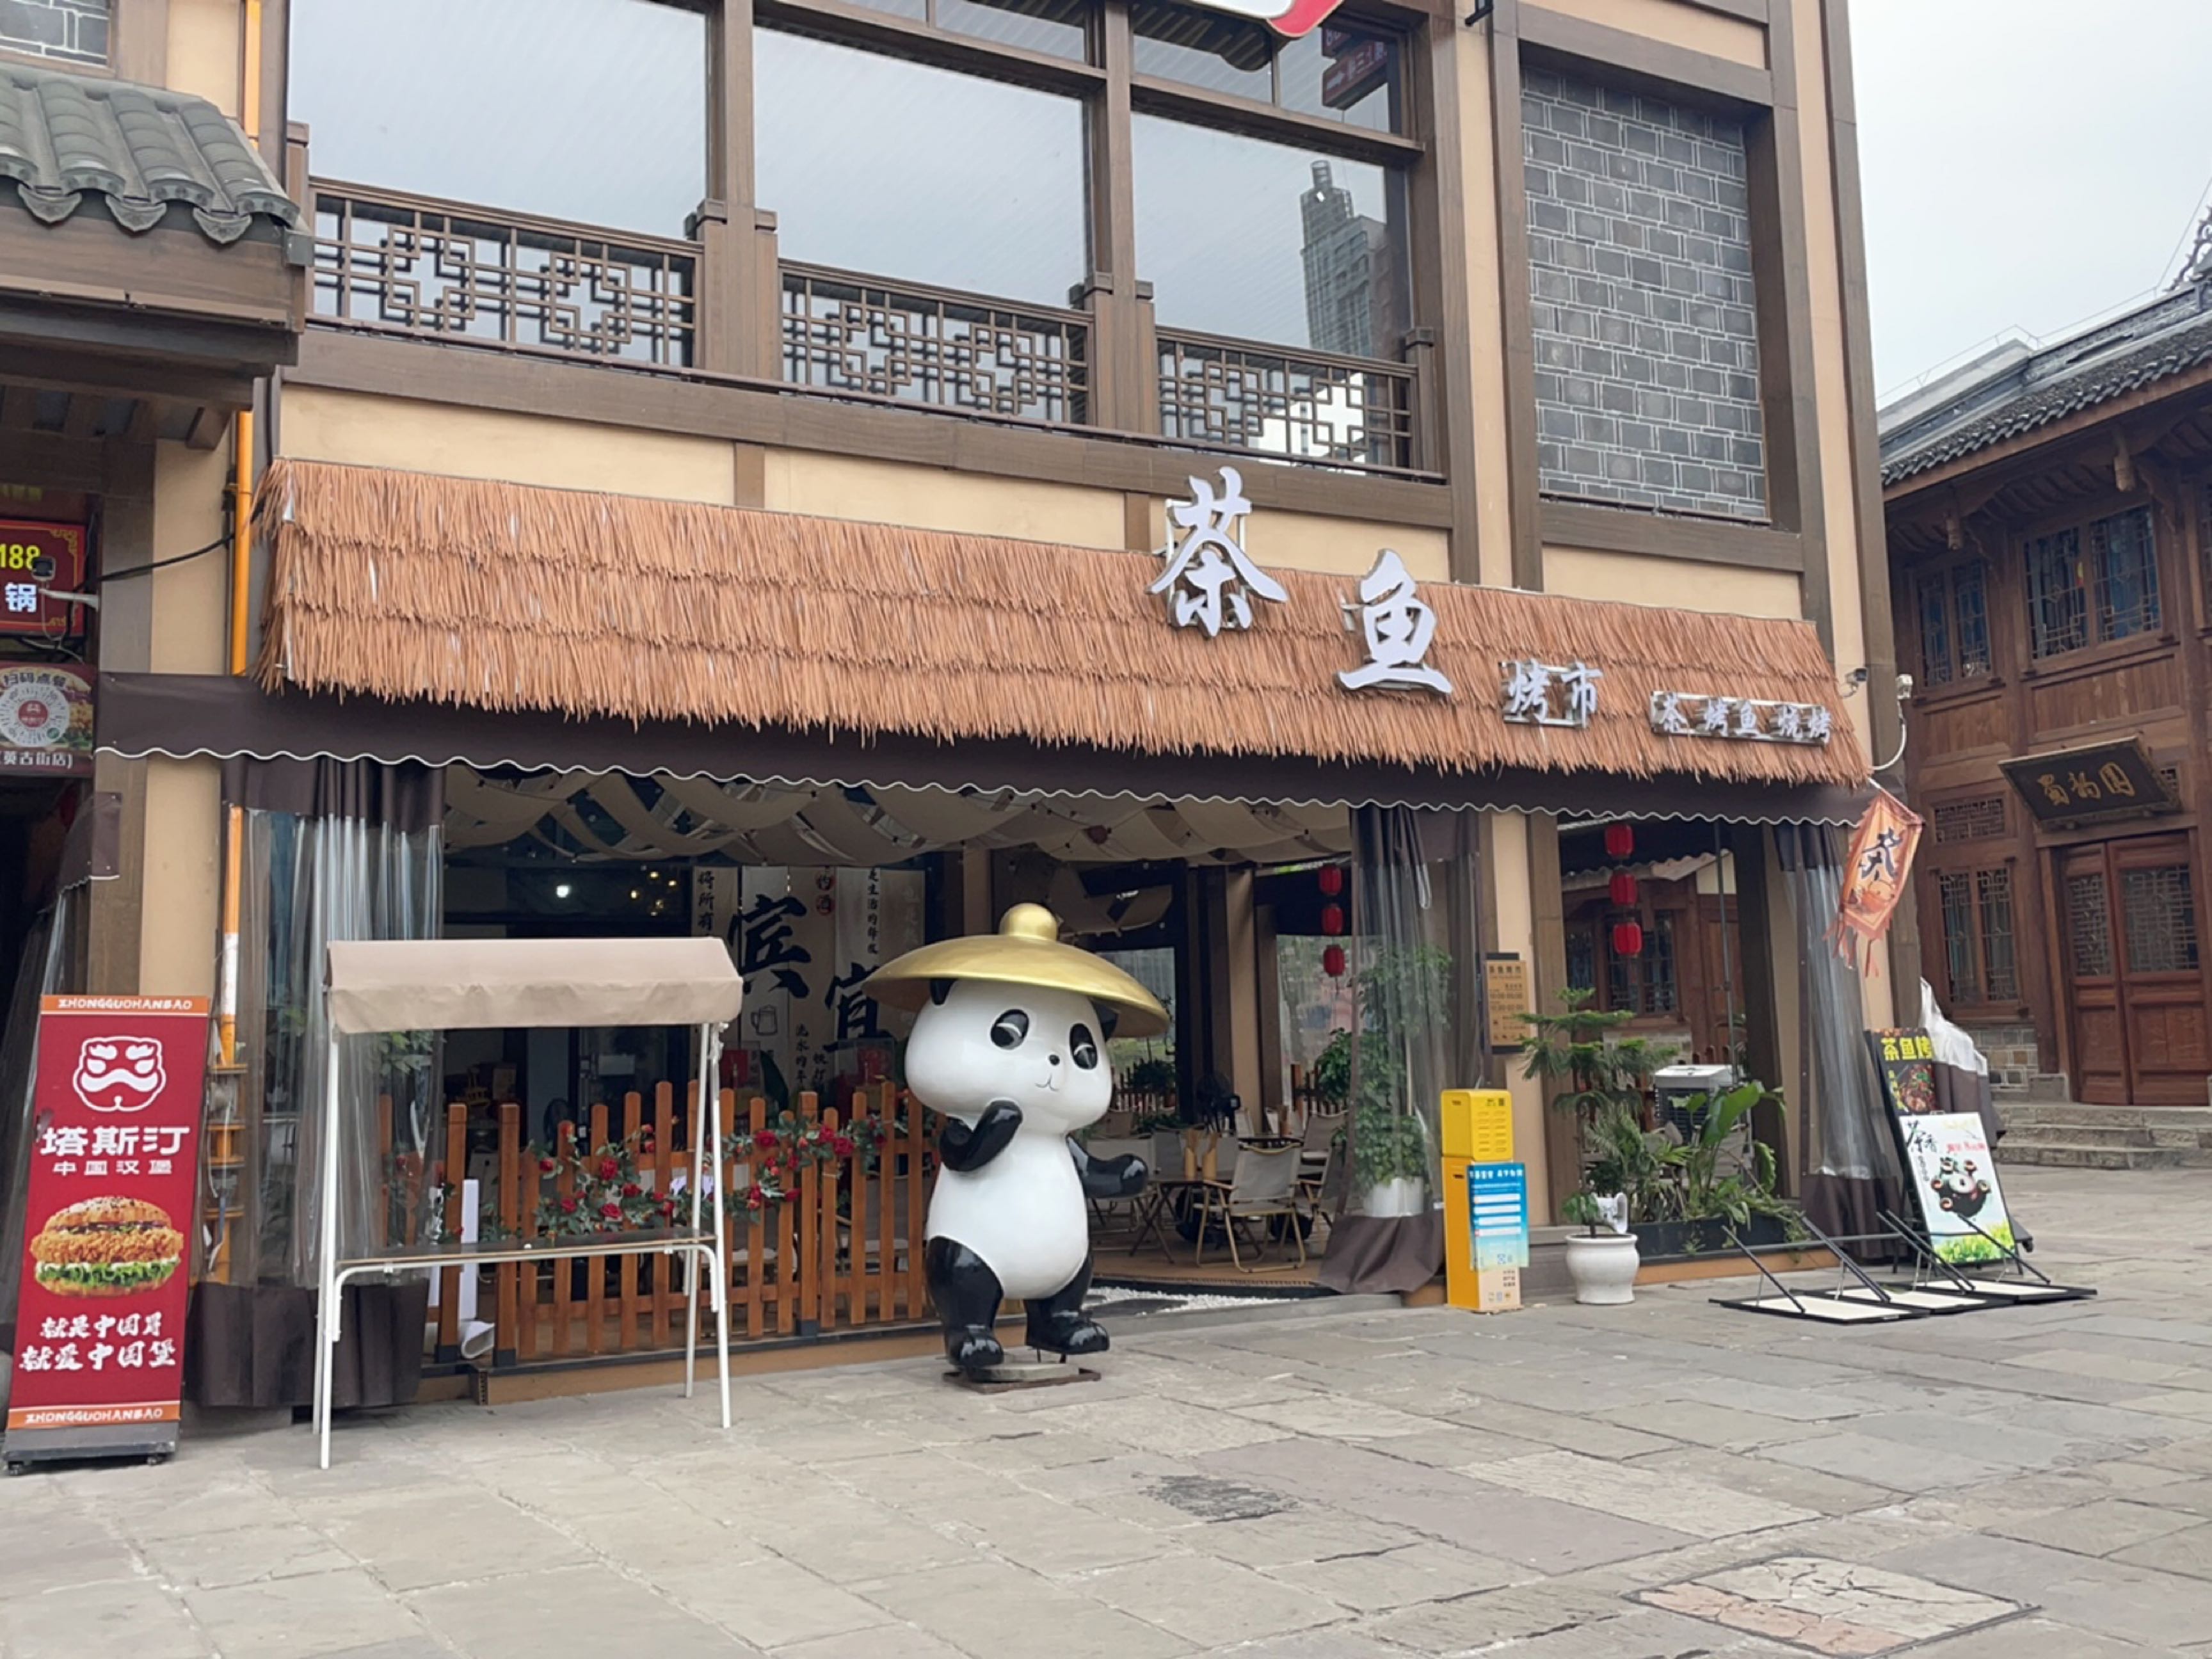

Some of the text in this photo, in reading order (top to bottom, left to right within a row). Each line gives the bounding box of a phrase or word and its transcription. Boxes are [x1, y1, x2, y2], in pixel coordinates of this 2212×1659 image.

[5, 582, 36, 613] 锅
[1507, 660, 1602, 722] 烤市
[58, 998, 193, 1010] ZHONGGUOHANBAO
[40, 1126, 190, 1157] 塔斯汀
[52, 1159, 172, 1176] 中国汉堡
[40, 1311, 162, 1338] 就是中国胃
[19, 1338, 176, 1372] 就爱中国堡
[26, 1408, 163, 1424] ZHONGGUOHANBAO
